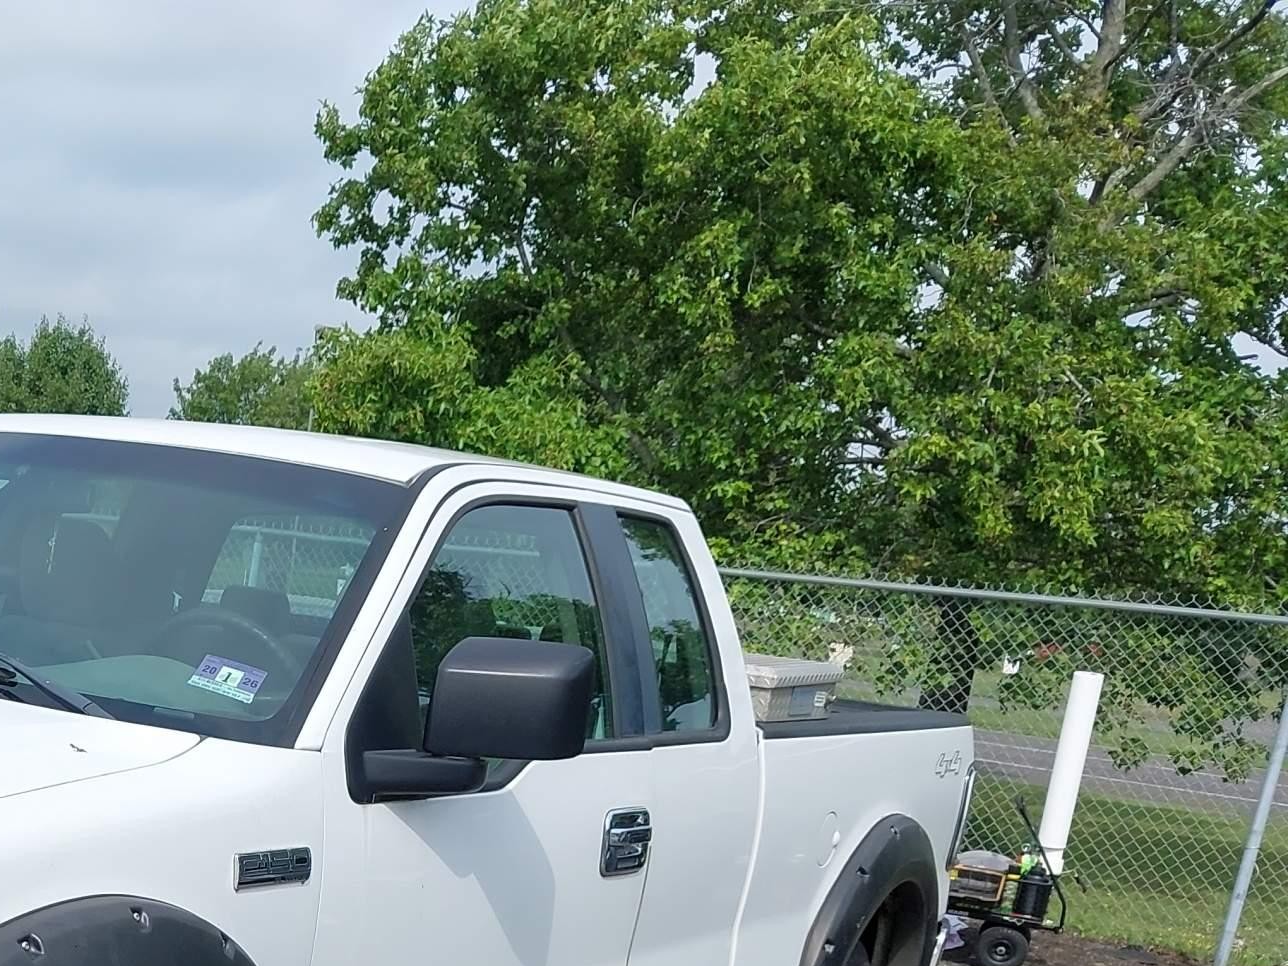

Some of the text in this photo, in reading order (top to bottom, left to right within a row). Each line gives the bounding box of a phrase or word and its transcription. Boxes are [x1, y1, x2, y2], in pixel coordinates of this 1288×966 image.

[201, 664, 218, 675] 20
[221, 671, 233, 683] 1
[242, 677, 259, 689] 26
[935, 750, 962, 778] 4x4
